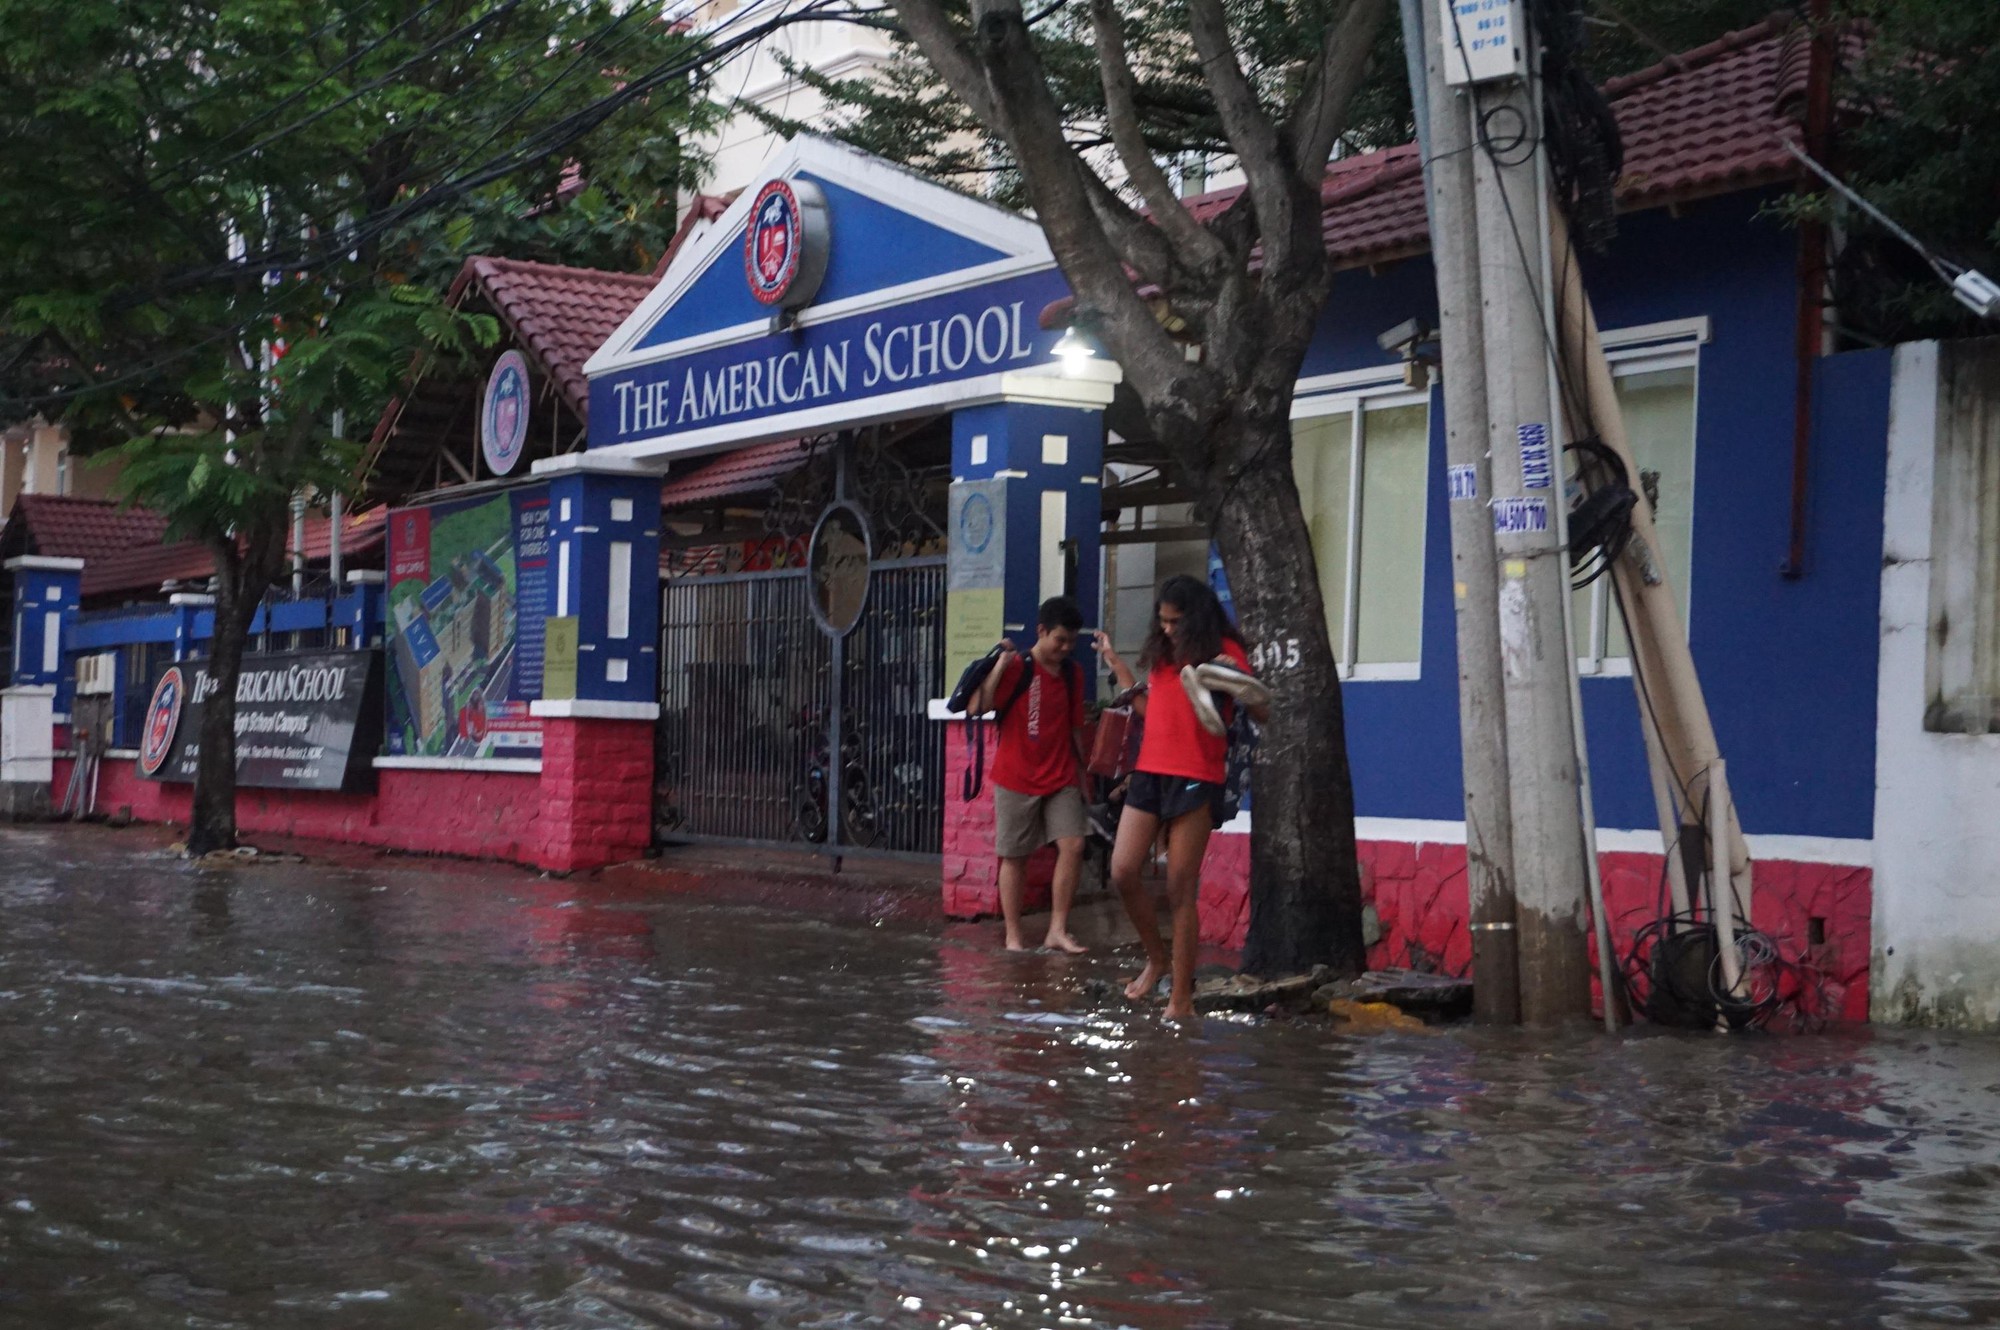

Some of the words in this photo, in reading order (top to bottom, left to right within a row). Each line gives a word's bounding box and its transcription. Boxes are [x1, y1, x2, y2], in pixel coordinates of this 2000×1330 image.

[614, 380, 670, 434] THE
[677, 340, 849, 424] AMERICAN
[863, 302, 1032, 387] SCHOOL
[284, 663, 347, 702] SCHOOL
